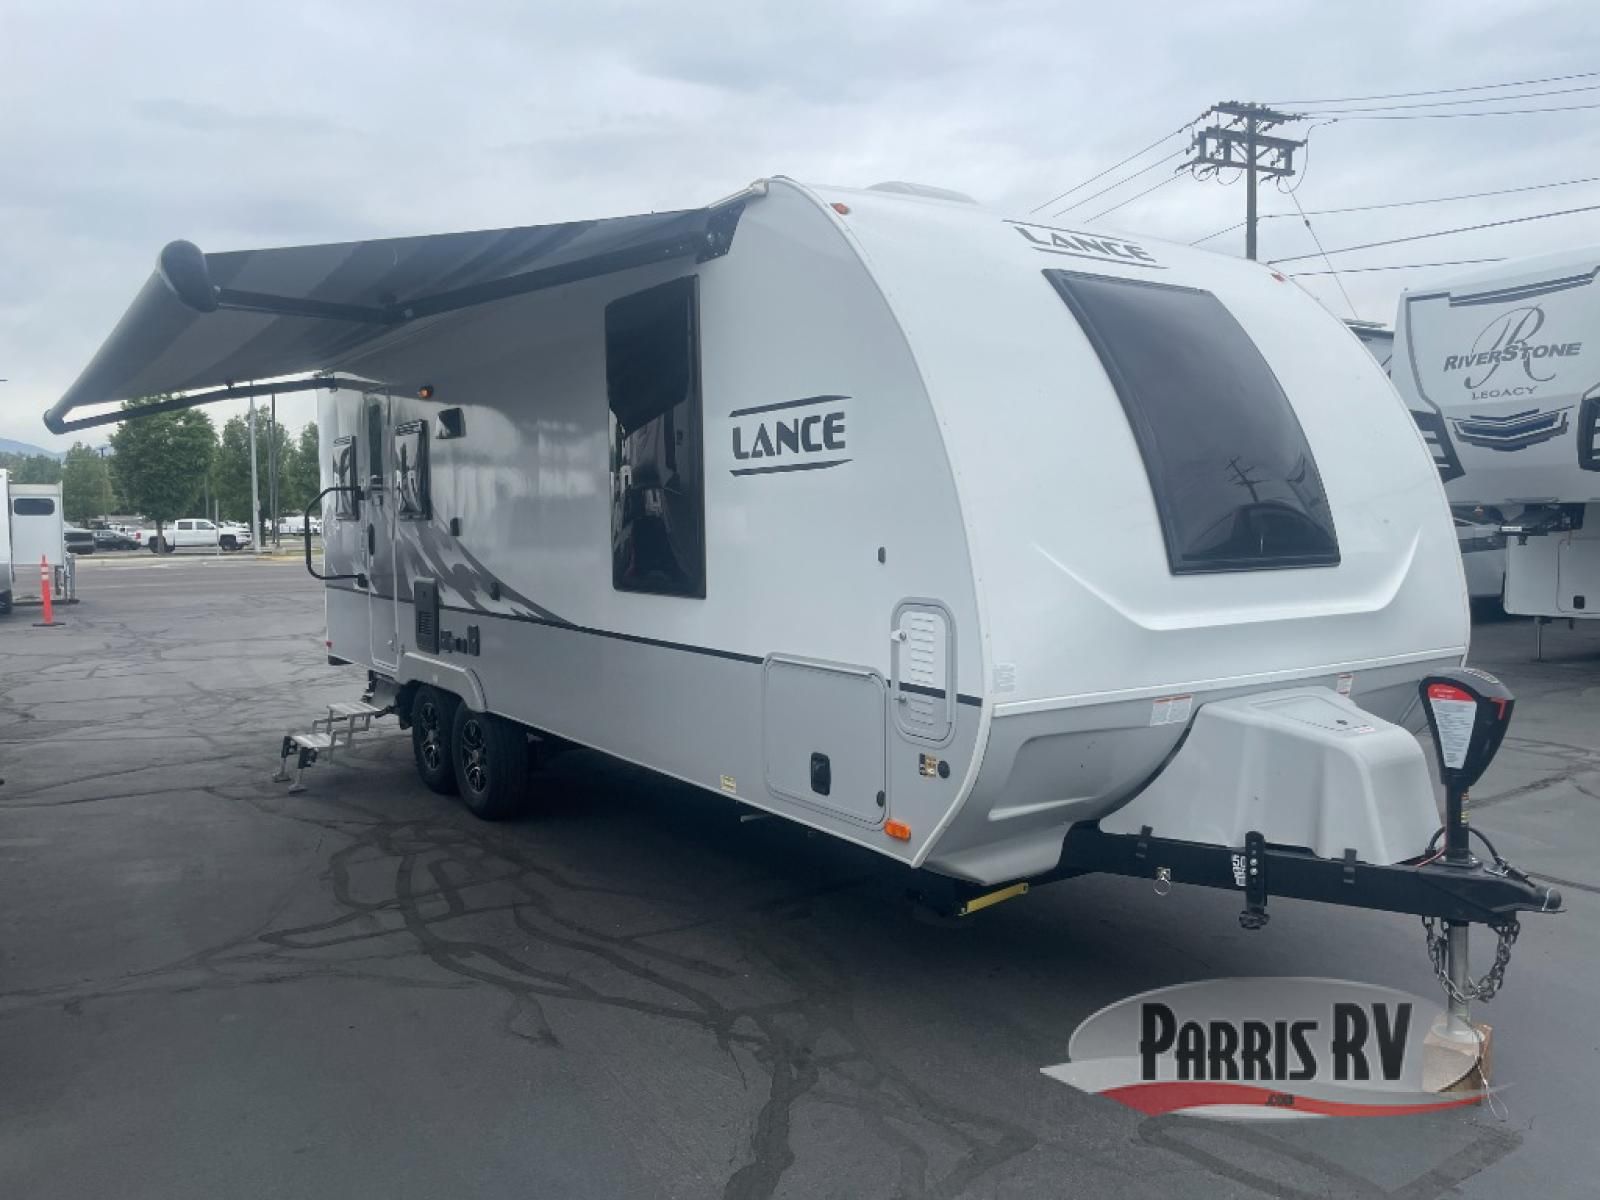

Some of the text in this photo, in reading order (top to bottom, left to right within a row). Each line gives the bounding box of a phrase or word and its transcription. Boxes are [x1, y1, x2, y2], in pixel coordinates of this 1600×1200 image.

[1013, 226, 1157, 263] LANCE
[1471, 385, 1538, 400] LEGACY
[732, 411, 846, 460] LANCE
